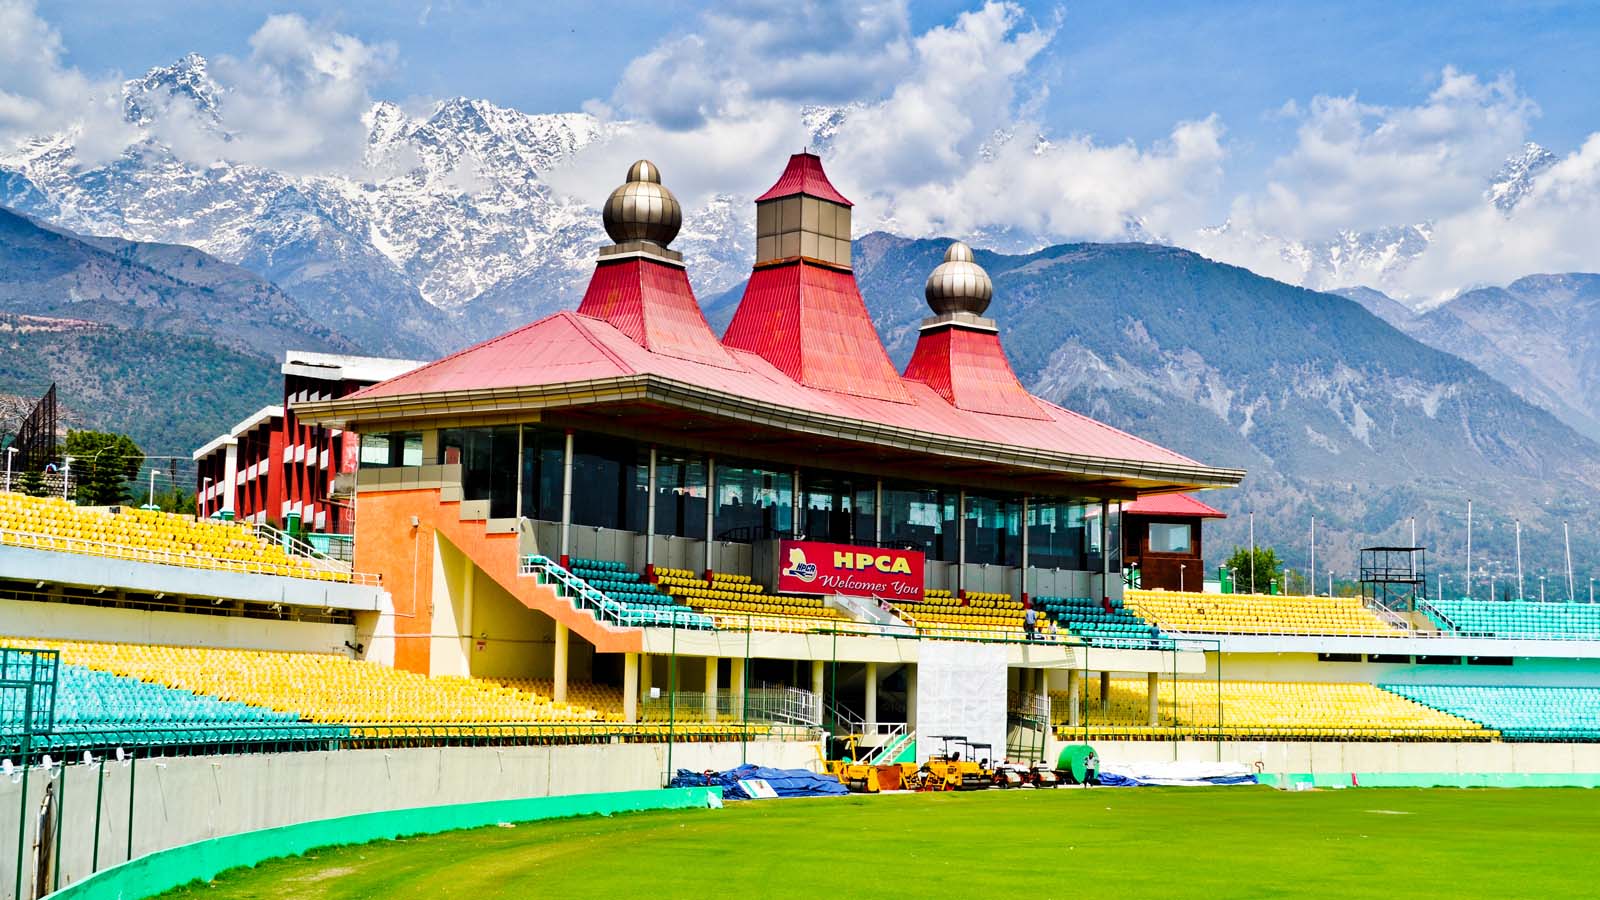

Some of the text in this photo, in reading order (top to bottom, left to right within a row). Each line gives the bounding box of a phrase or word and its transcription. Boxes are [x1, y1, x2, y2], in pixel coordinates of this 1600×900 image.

[796, 563, 816, 572] HPCA
[833, 551, 912, 575] HPCA
[818, 575, 919, 595] Welcomes You
